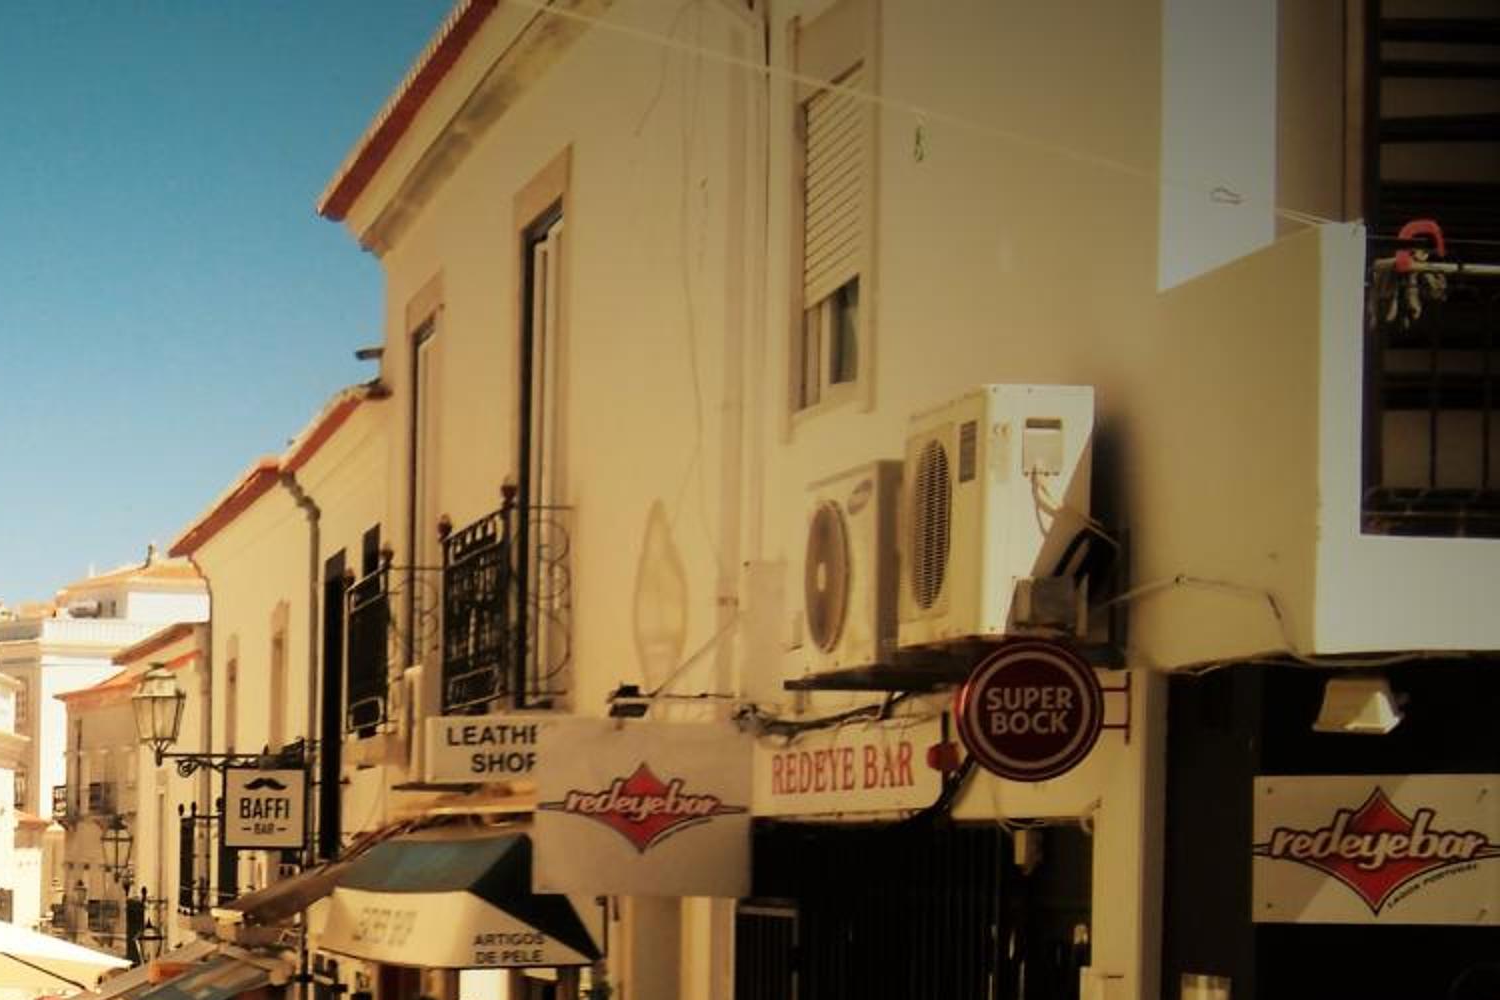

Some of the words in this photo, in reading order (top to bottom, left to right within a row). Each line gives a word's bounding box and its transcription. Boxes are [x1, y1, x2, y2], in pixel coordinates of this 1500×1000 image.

[986, 686, 1073, 711] SUPER
[990, 711, 1070, 735] BOCK
[771, 747, 855, 796] REDEYE
[862, 741, 915, 790] BAR
[239, 797, 290, 820] BAFFI
[565, 778, 719, 823] redeyebar
[253, 822, 275, 835] BAR
[1269, 808, 1488, 870] redeyebar
[473, 933, 545, 946] ARTIGOS
[475, 951, 497, 964] DE
[501, 949, 544, 963] PELE
